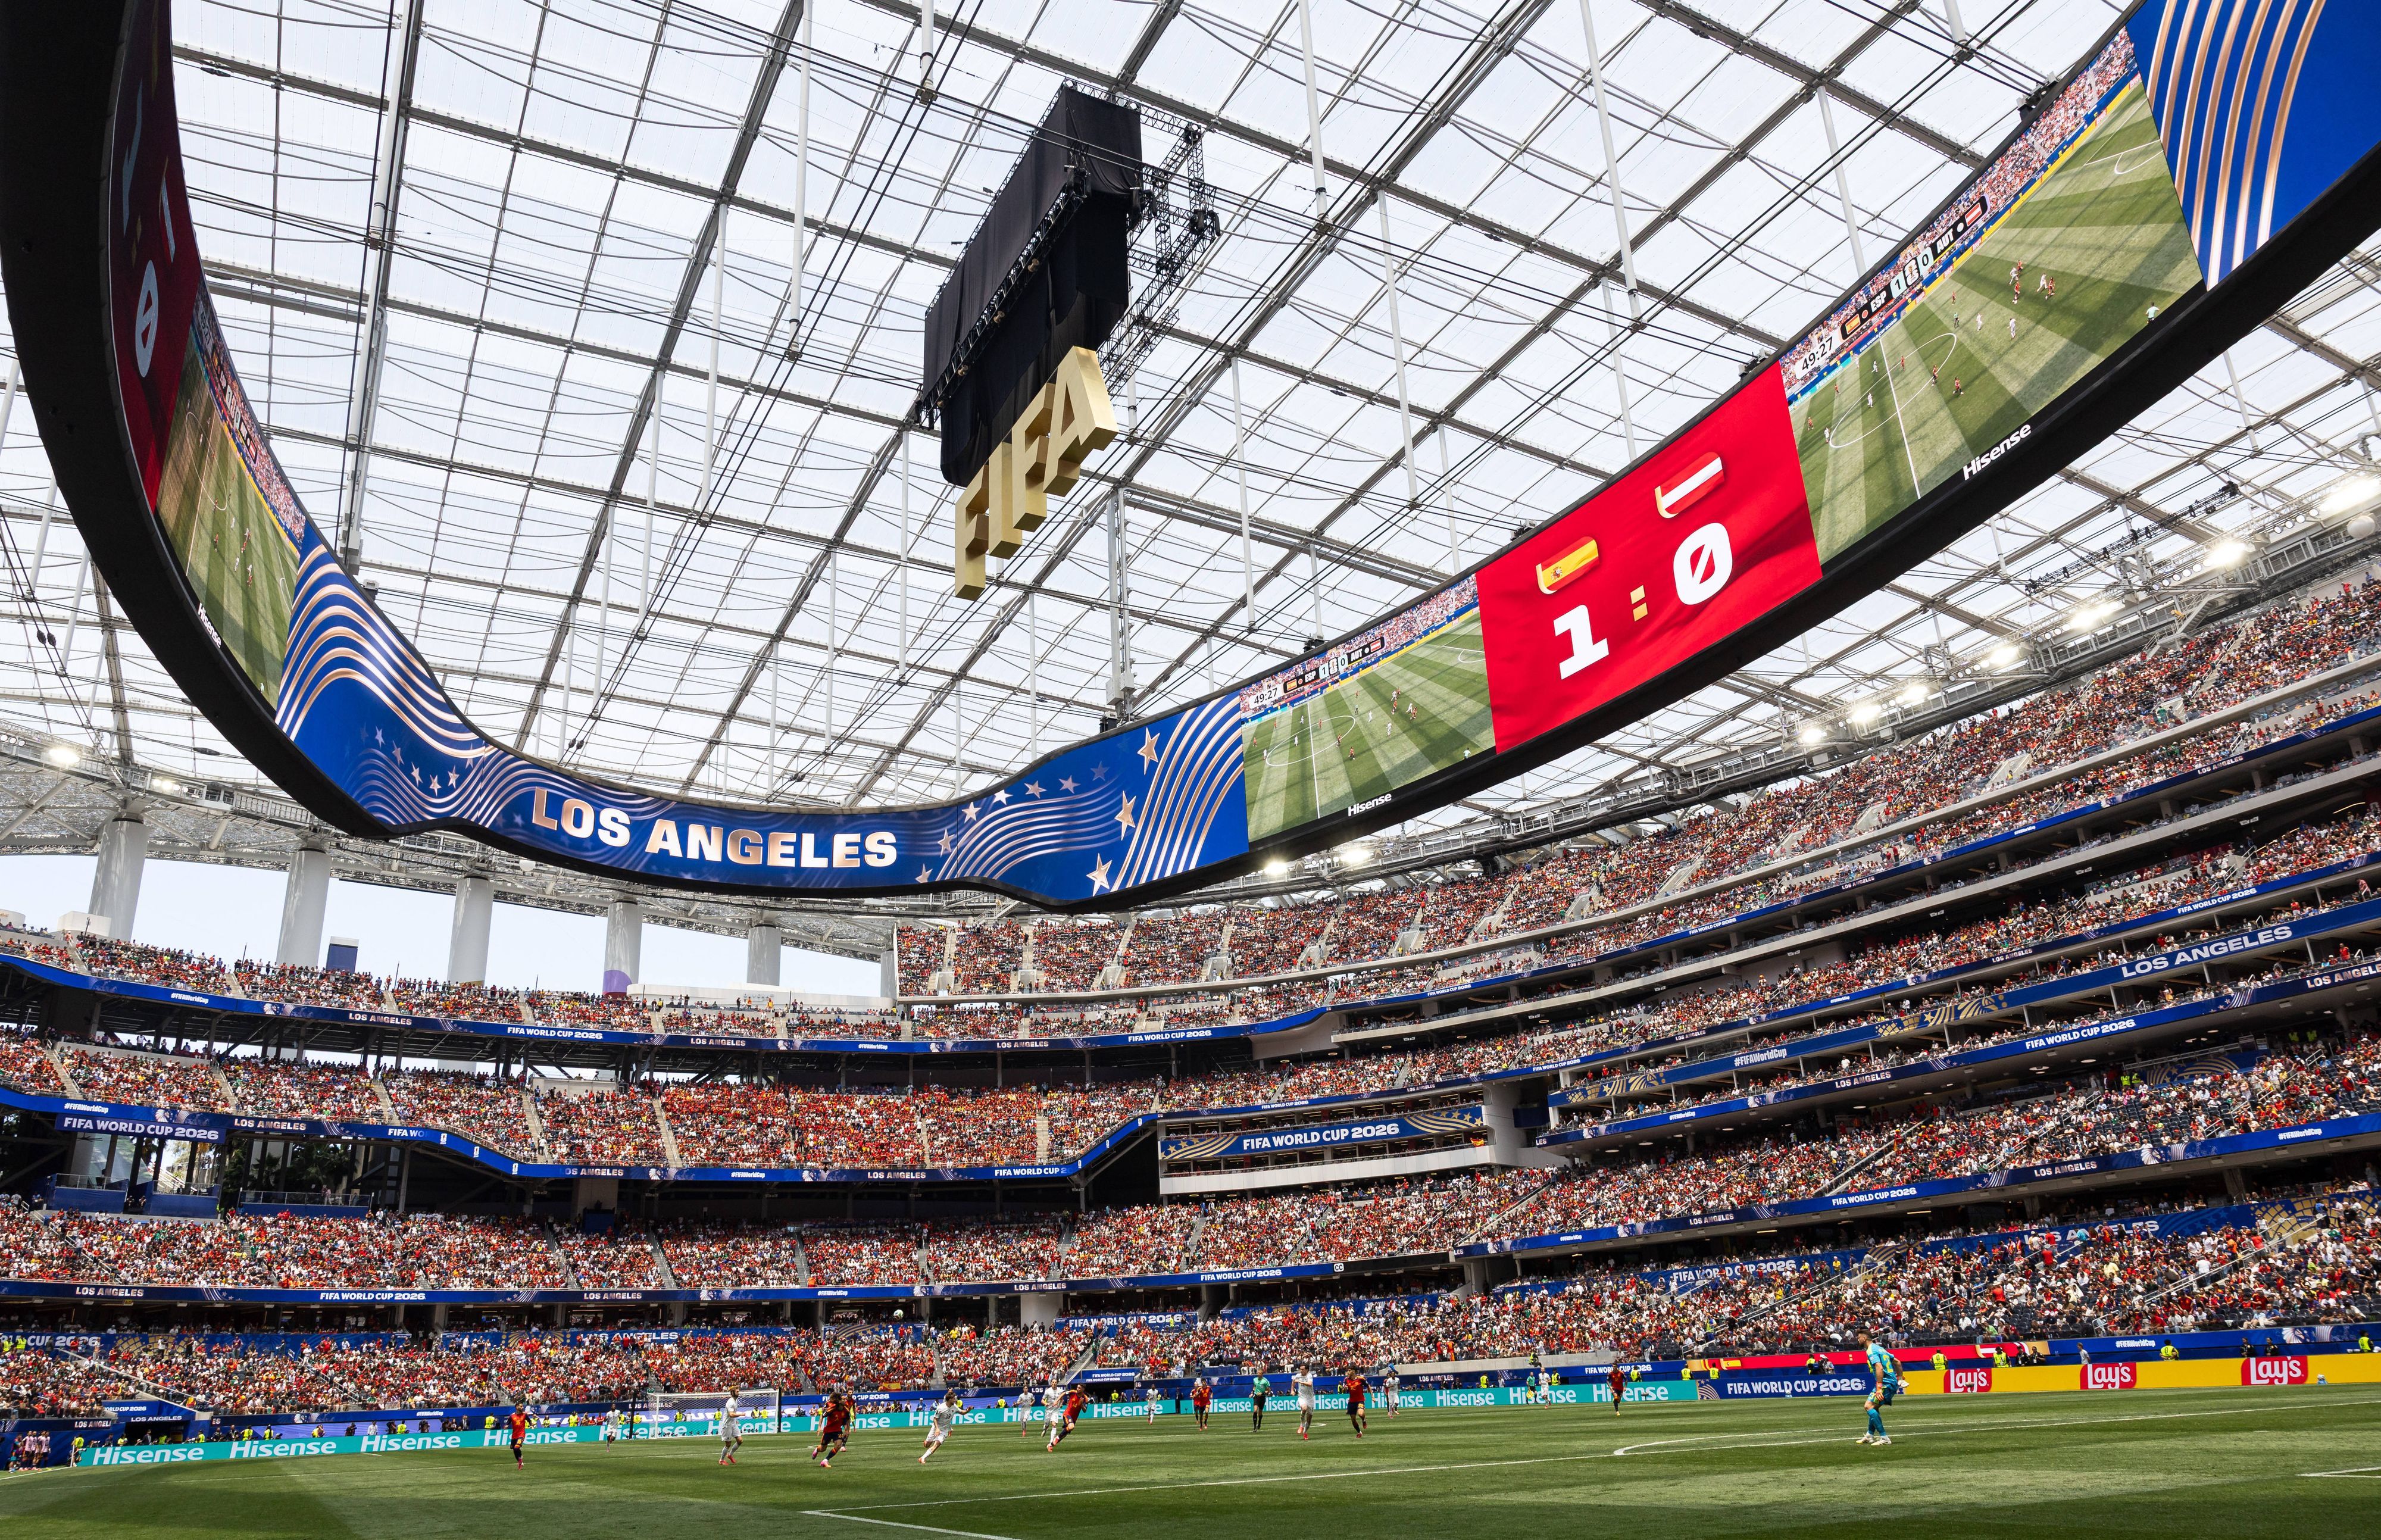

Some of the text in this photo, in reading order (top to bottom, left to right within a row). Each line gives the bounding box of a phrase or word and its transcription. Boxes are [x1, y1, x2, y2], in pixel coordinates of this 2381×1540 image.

[1870, 290, 1887, 313] ESP
[1936, 233, 1954, 254] AUT
[1802, 336, 1833, 370] 49:27
[1963, 424, 2031, 480] Hisense
[955, 345, 1119, 601] FIFA
[1553, 523, 1733, 680] 1 0
[198, 602, 221, 648] Hisense
[1305, 649, 1363, 683] ESP AUT
[1254, 688, 1277, 705] 49:27
[2197, 755, 2243, 774] LOS ANGELES
[1348, 793, 1392, 817] Hisense
[532, 786, 898, 869] LOS ANGELES
[1854, 876, 1874, 887] ANGELES
[2177, 888, 2257, 914] FIFA WORLD CUP 2026
[1699, 924, 1713, 933] WORLD
[1721, 917, 1736, 926] 2026
[2005, 948, 2033, 961] ANGELES
[2121, 926, 2292, 977] LOS ANGELES
[1577, 958, 1596, 966] ANGELES
[2306, 974, 2331, 988] LOS
[171, 992, 209, 1004] #FIFAWorldCup
[349, 1013, 413, 1026] LOS ANGELES
[507, 1027, 525, 1035] FIFA
[526, 1028, 555, 1037] WORLD
[574, 1031, 603, 1039] 2026
[1687, 1030, 1707, 1039] ANGELES
[2025, 1019, 2136, 1049] FIFA WORLD CUP 2026
[708, 1038, 746, 1047] ANGELES
[1734, 1048, 1787, 1067] #FIFAWorldCup
[1835, 1071, 1892, 1089] LOS ANGELES
[64, 1102, 109, 1114] #FIFAWorldCup
[64, 1117, 219, 1141] FIFA WORLD CUP 2026
[234, 1119, 307, 1131] LOS ANGELES
[388, 1129, 409, 1138] FIFA
[1243, 1123, 1400, 1150] FIFA WORLD CUP 2026
[2277, 1128, 2322, 1141] #FIFAWorldCup
[580, 1169, 624, 1177] ANGELES
[1012, 1168, 1042, 1176] WORLD
[2033, 1161, 2098, 1177] LOS ANGELES
[1832, 1188, 1917, 1206] FIFA WORLD CUP 2026
[1704, 1214, 1734, 1224] ANGELES
[1216, 1272, 1241, 1280] WORLD
[1242, 1270, 1255, 1279] CUP
[1257, 1269, 1282, 1277] 2026
[1673, 1260, 1796, 1282] FIFA 2026
[76, 1286, 144, 1297] LOS ANGELES
[1069, 1319, 1089, 1327] FIFA
[2116, 1339, 2156, 1348] #FIFAWorldCup
[2088, 1363, 2132, 1389] Lay's
[2250, 1356, 2302, 1385] Lay's
[1727, 1382, 1751, 1395] FIFA
[1751, 1380, 1792, 1394] WORLD
[1795, 1380, 1817, 1392] CUP
[1950, 1368, 1988, 1394] Lay's
[1436, 1389, 1494, 1407] Hisense
[230, 1440, 336, 1458] Hisense
[361, 1435, 461, 1452] Hisense
[93, 1446, 204, 1465] Hisense
